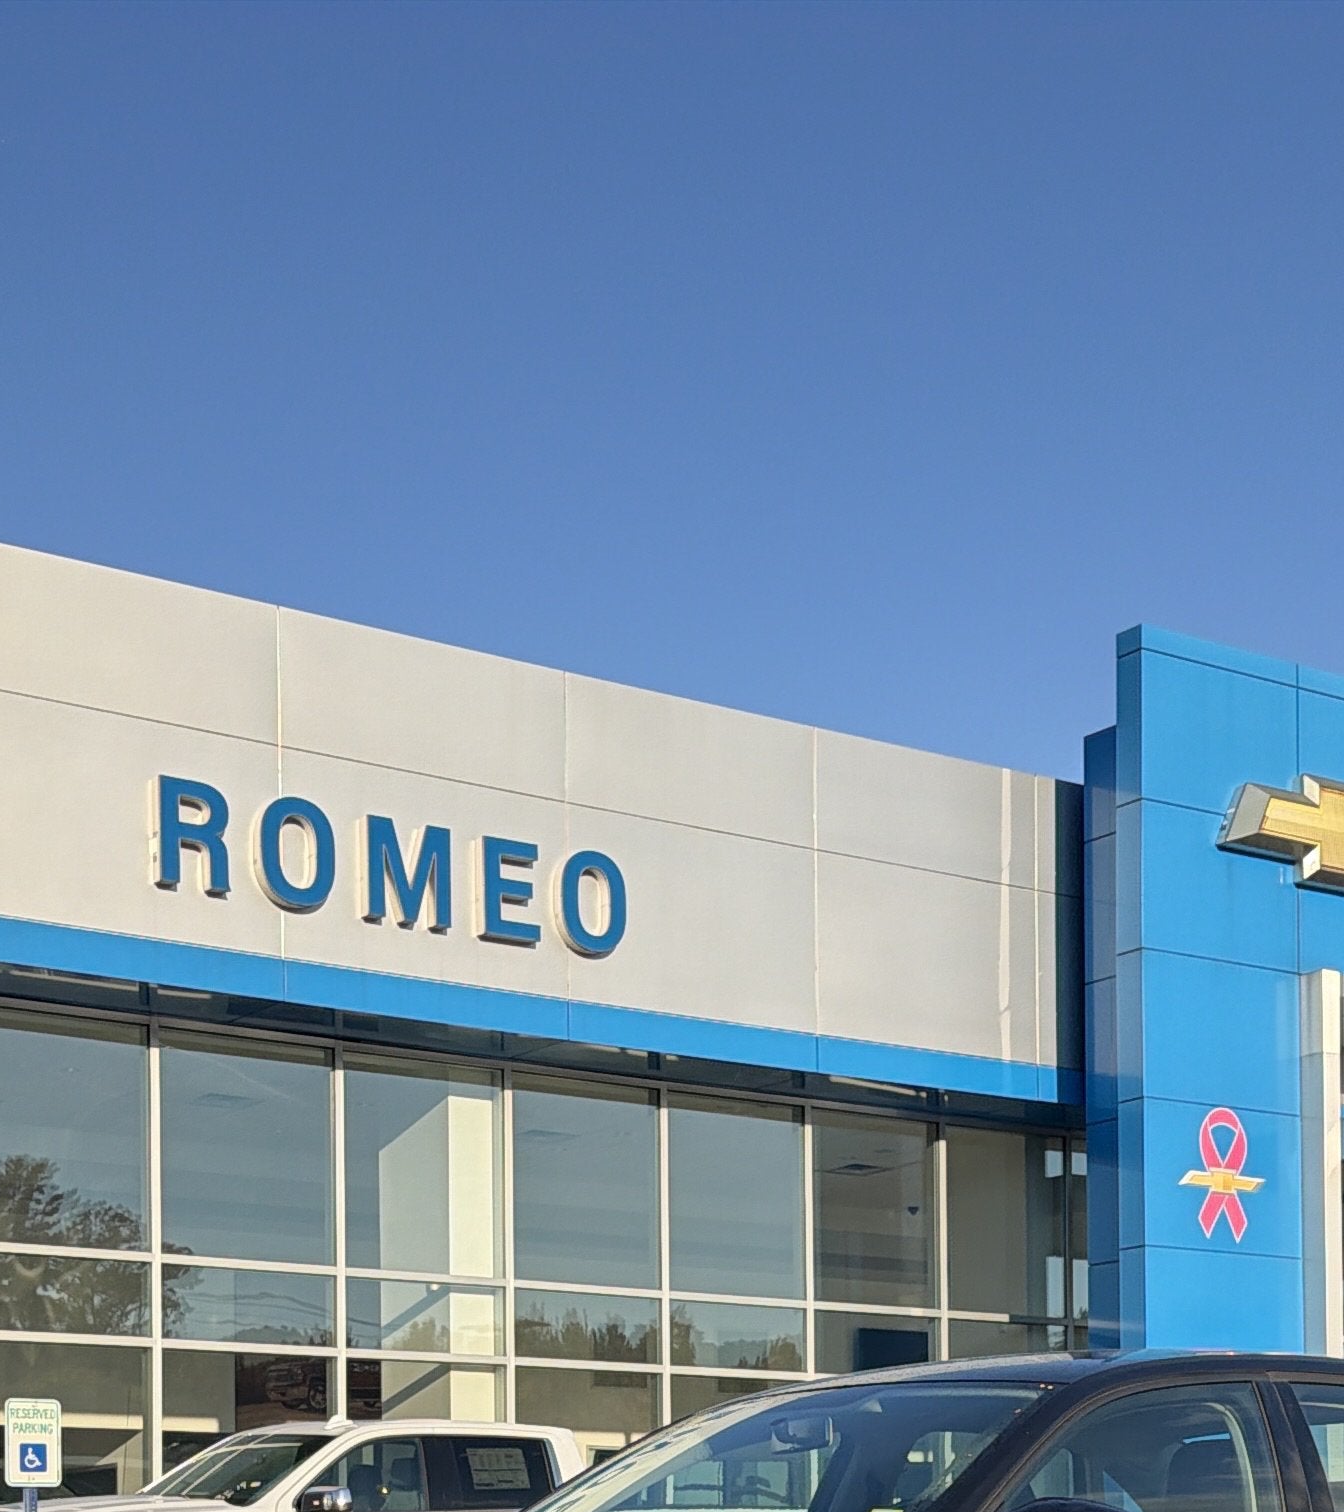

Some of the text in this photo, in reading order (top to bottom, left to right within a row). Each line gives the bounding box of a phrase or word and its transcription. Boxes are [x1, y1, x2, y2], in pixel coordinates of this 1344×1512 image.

[154, 774, 626, 957] ROMEO
[9, 1408, 56, 1419] RESERVED
[12, 1422, 54, 1434] PARKING
